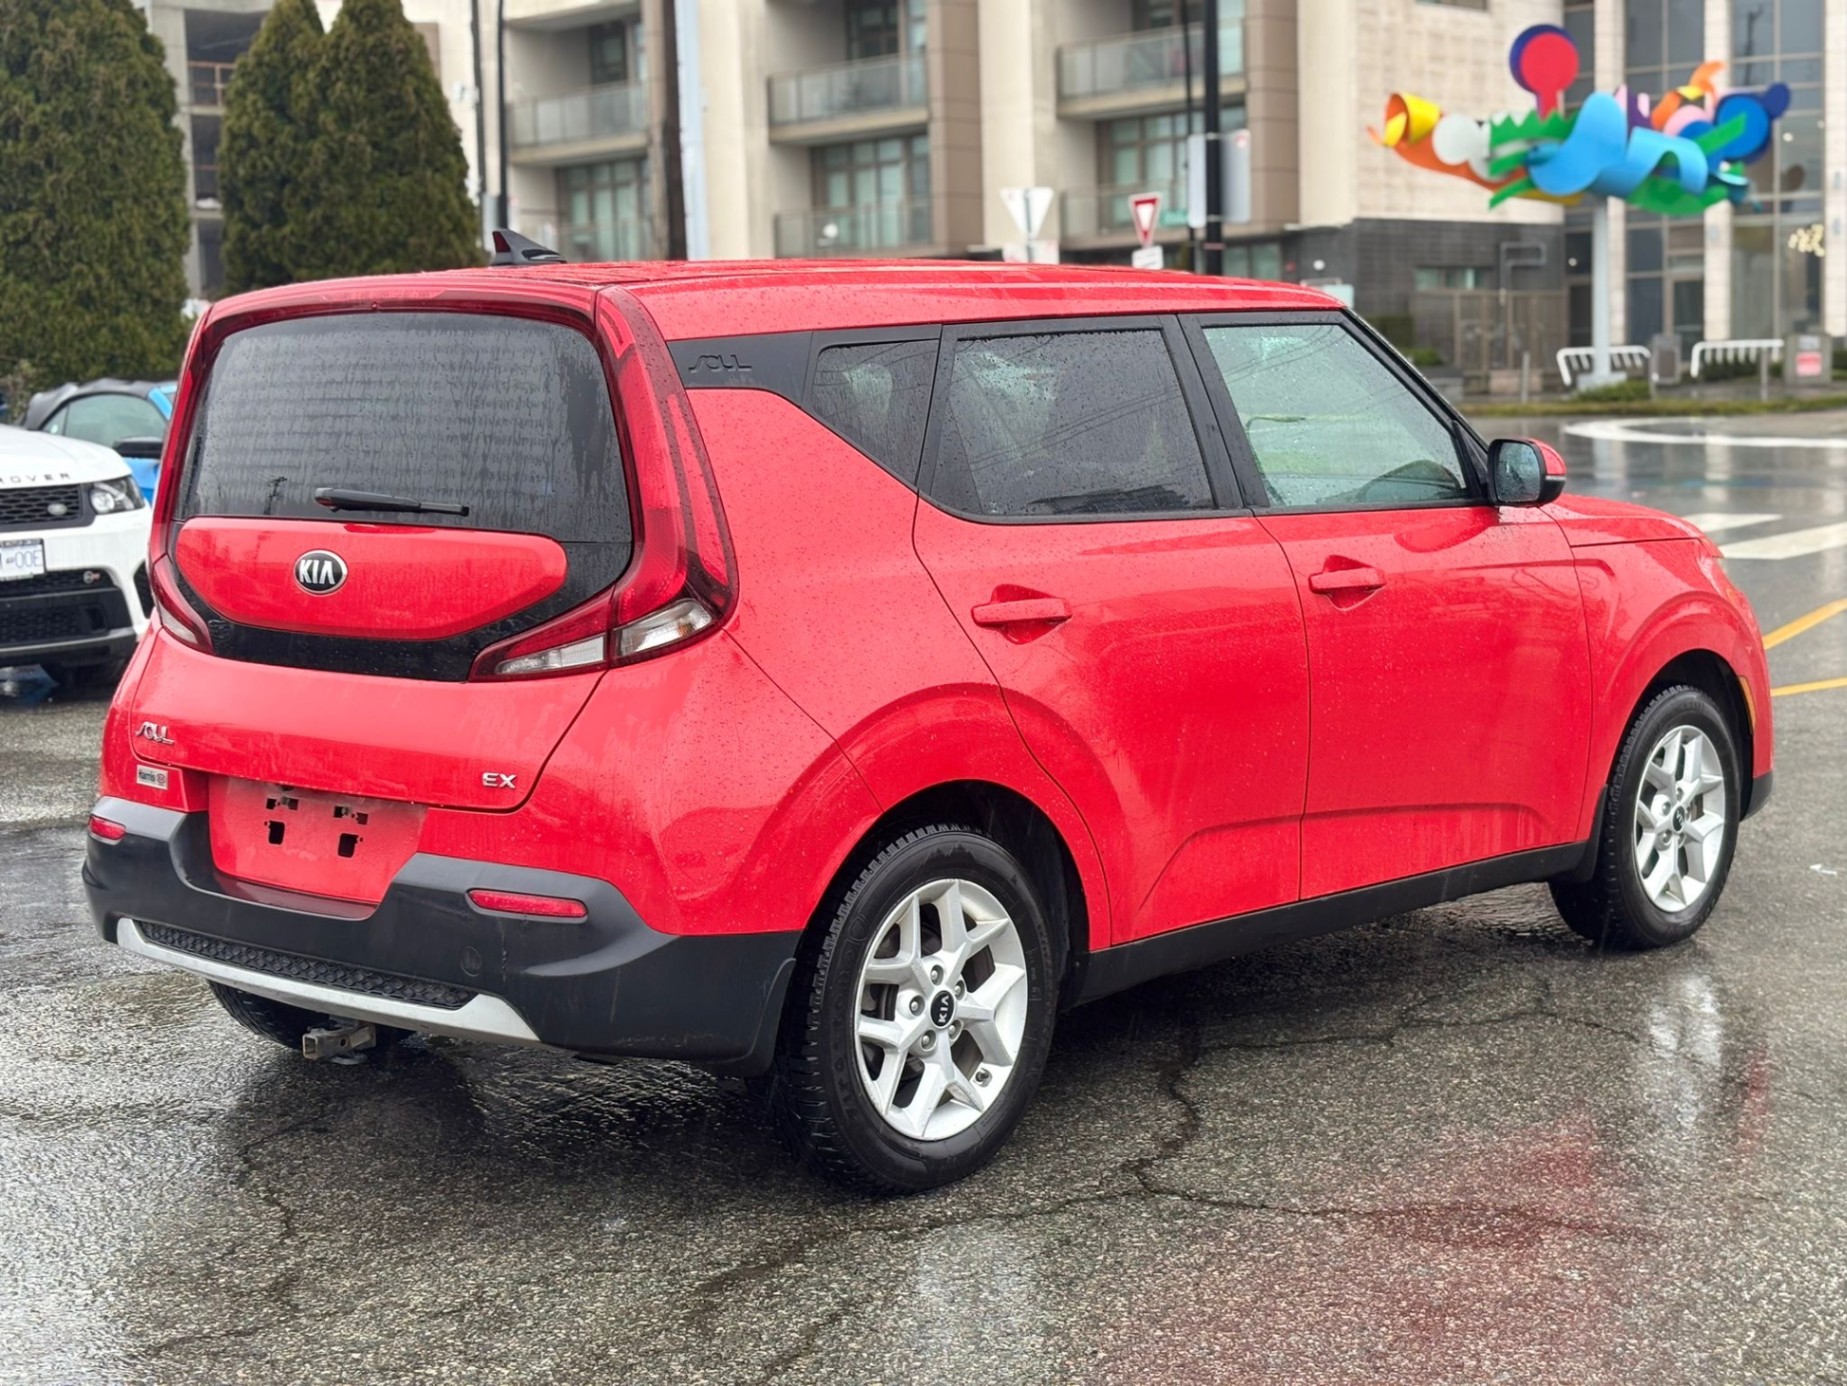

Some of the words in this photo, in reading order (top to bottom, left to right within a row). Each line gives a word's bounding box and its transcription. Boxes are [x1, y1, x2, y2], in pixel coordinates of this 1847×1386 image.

[299, 559, 336, 585] KIA
[135, 721, 175, 745] SOUL
[482, 771, 517, 789] EX
[938, 995, 949, 1023] KIA
